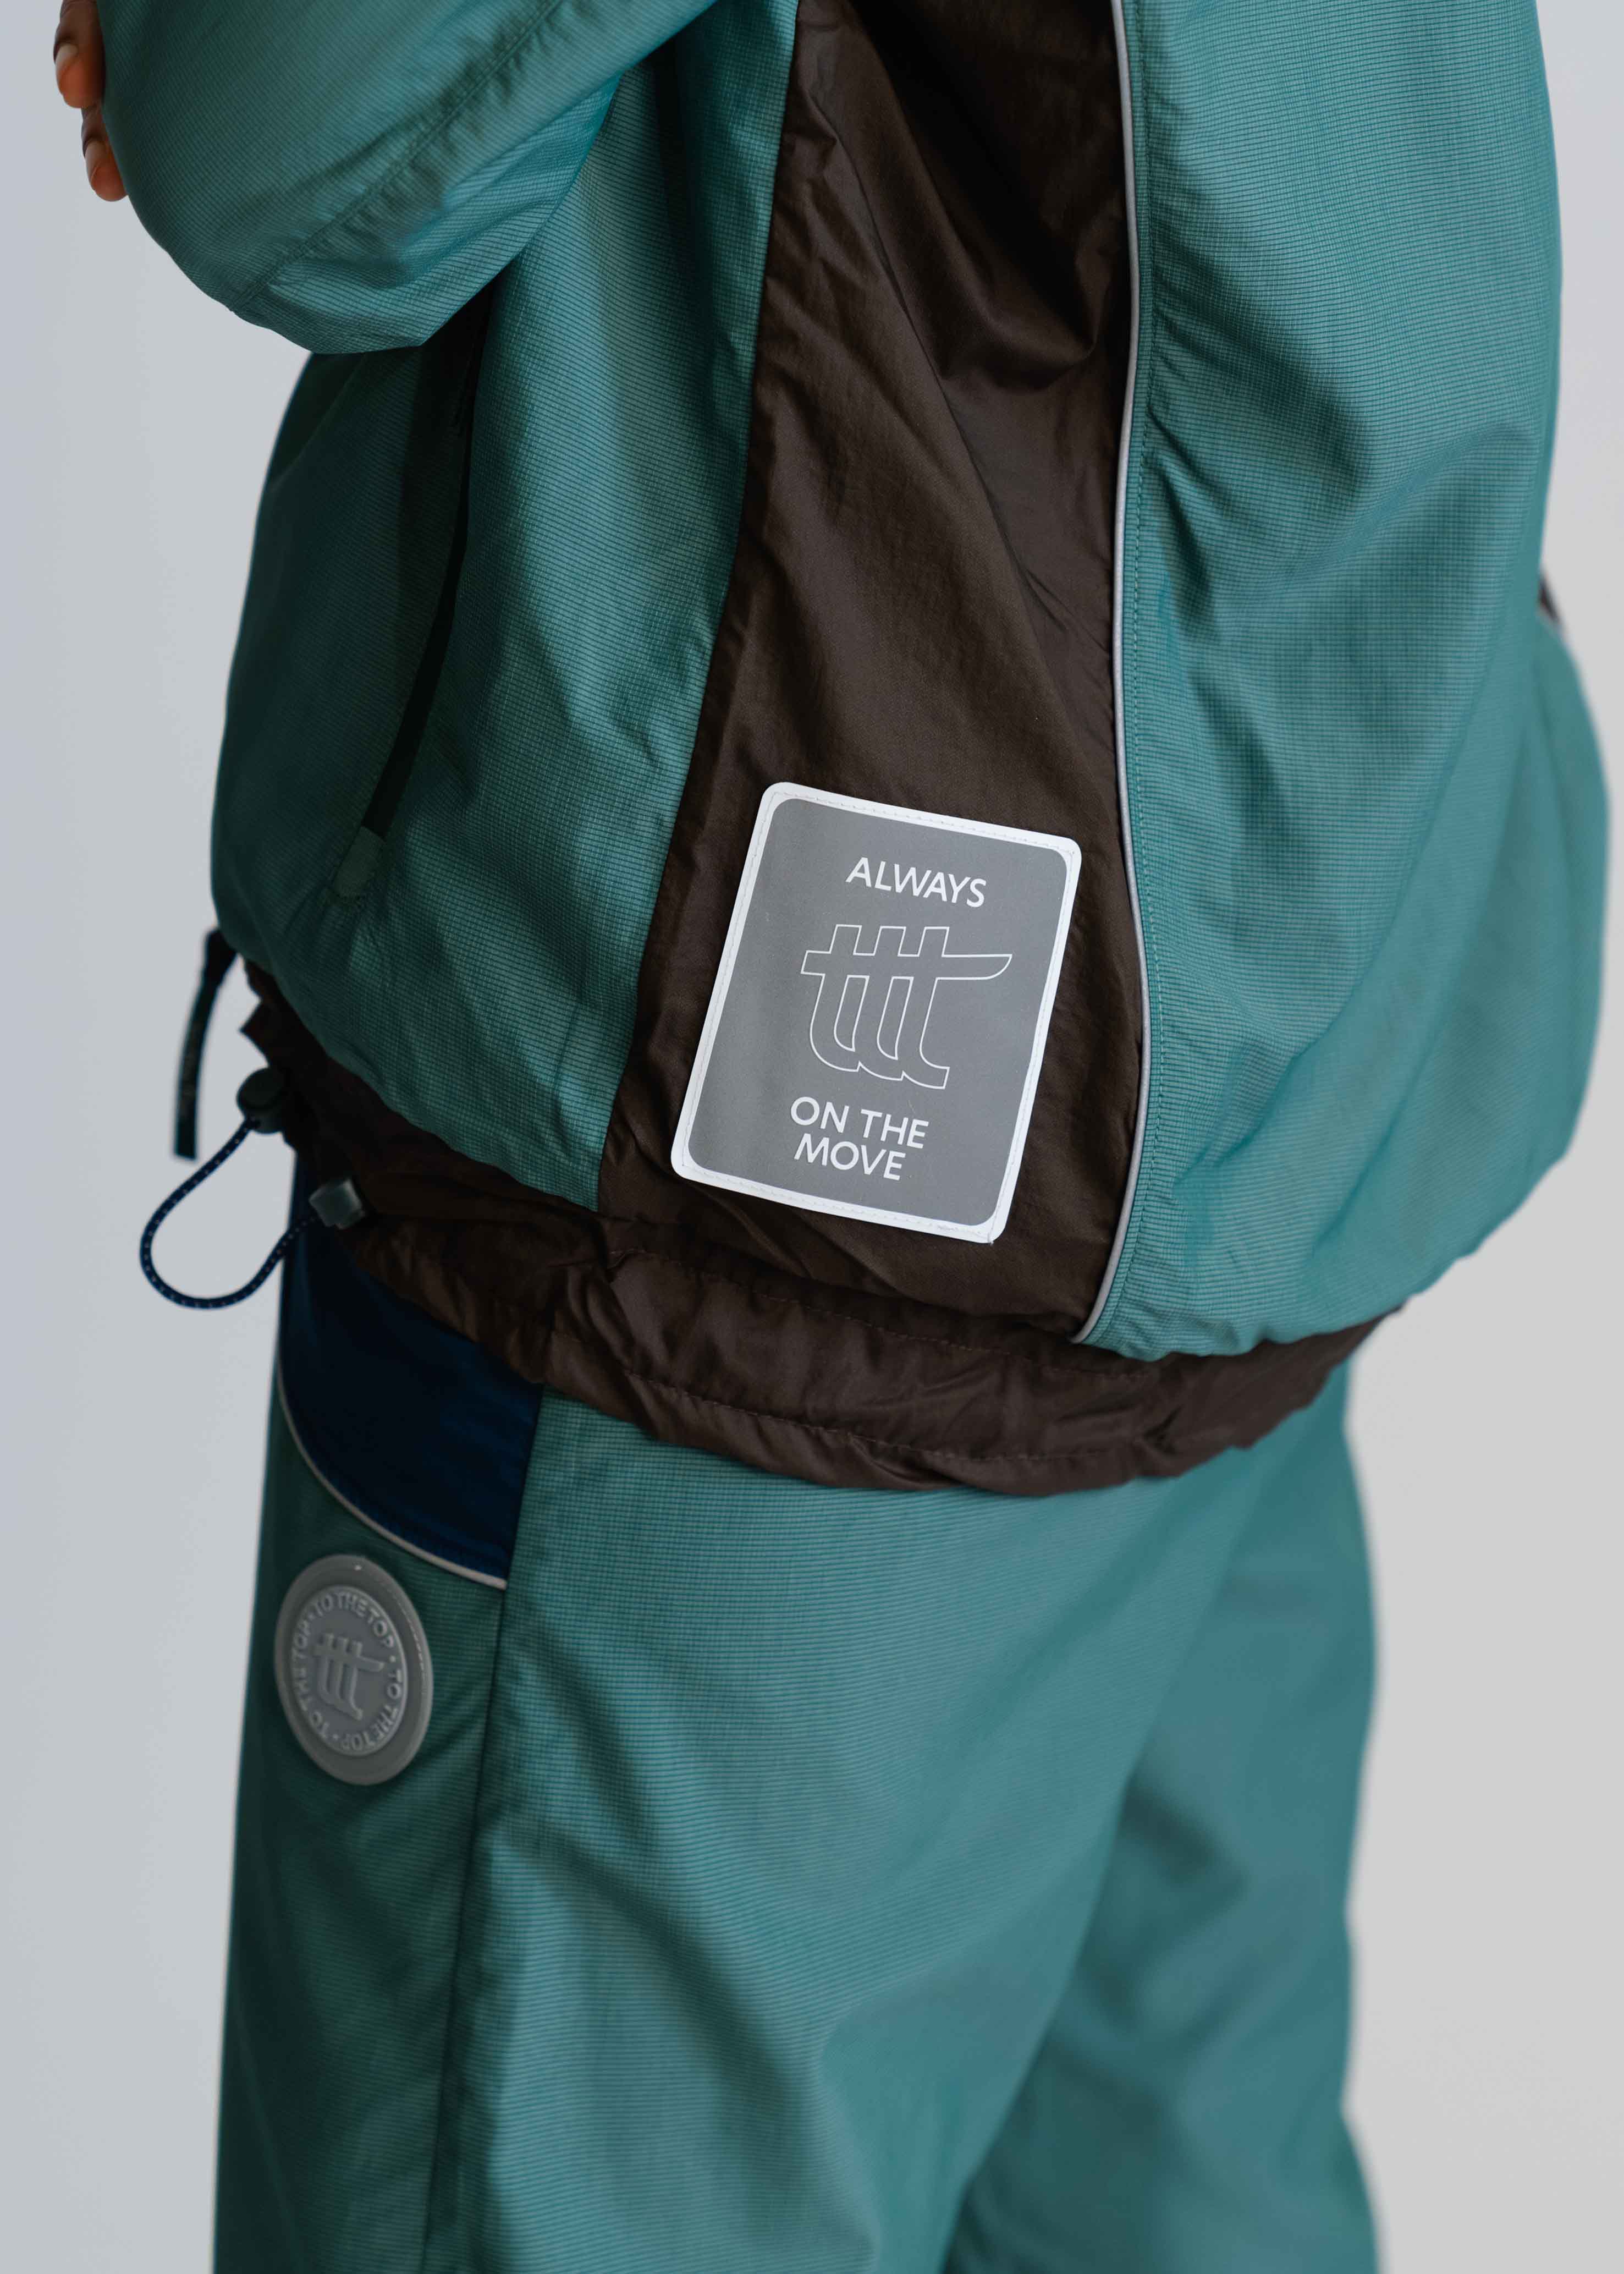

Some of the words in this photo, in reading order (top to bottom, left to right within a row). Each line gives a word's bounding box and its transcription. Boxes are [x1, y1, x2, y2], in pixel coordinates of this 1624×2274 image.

[845, 856, 987, 908] ALWAYS
[790, 1096, 850, 1133] ON
[860, 1108, 929, 1150] THE
[794, 1133, 906, 1181] MOVE
[311, 1593, 334, 1617] TO
[336, 1592, 368, 1617] THE
[367, 1607, 395, 1648] TOP
[387, 1669, 402, 1700] TO
[309, 1711, 331, 1741] TO
[341, 1731, 377, 1752] TOP
[369, 1704, 399, 1741] THE
